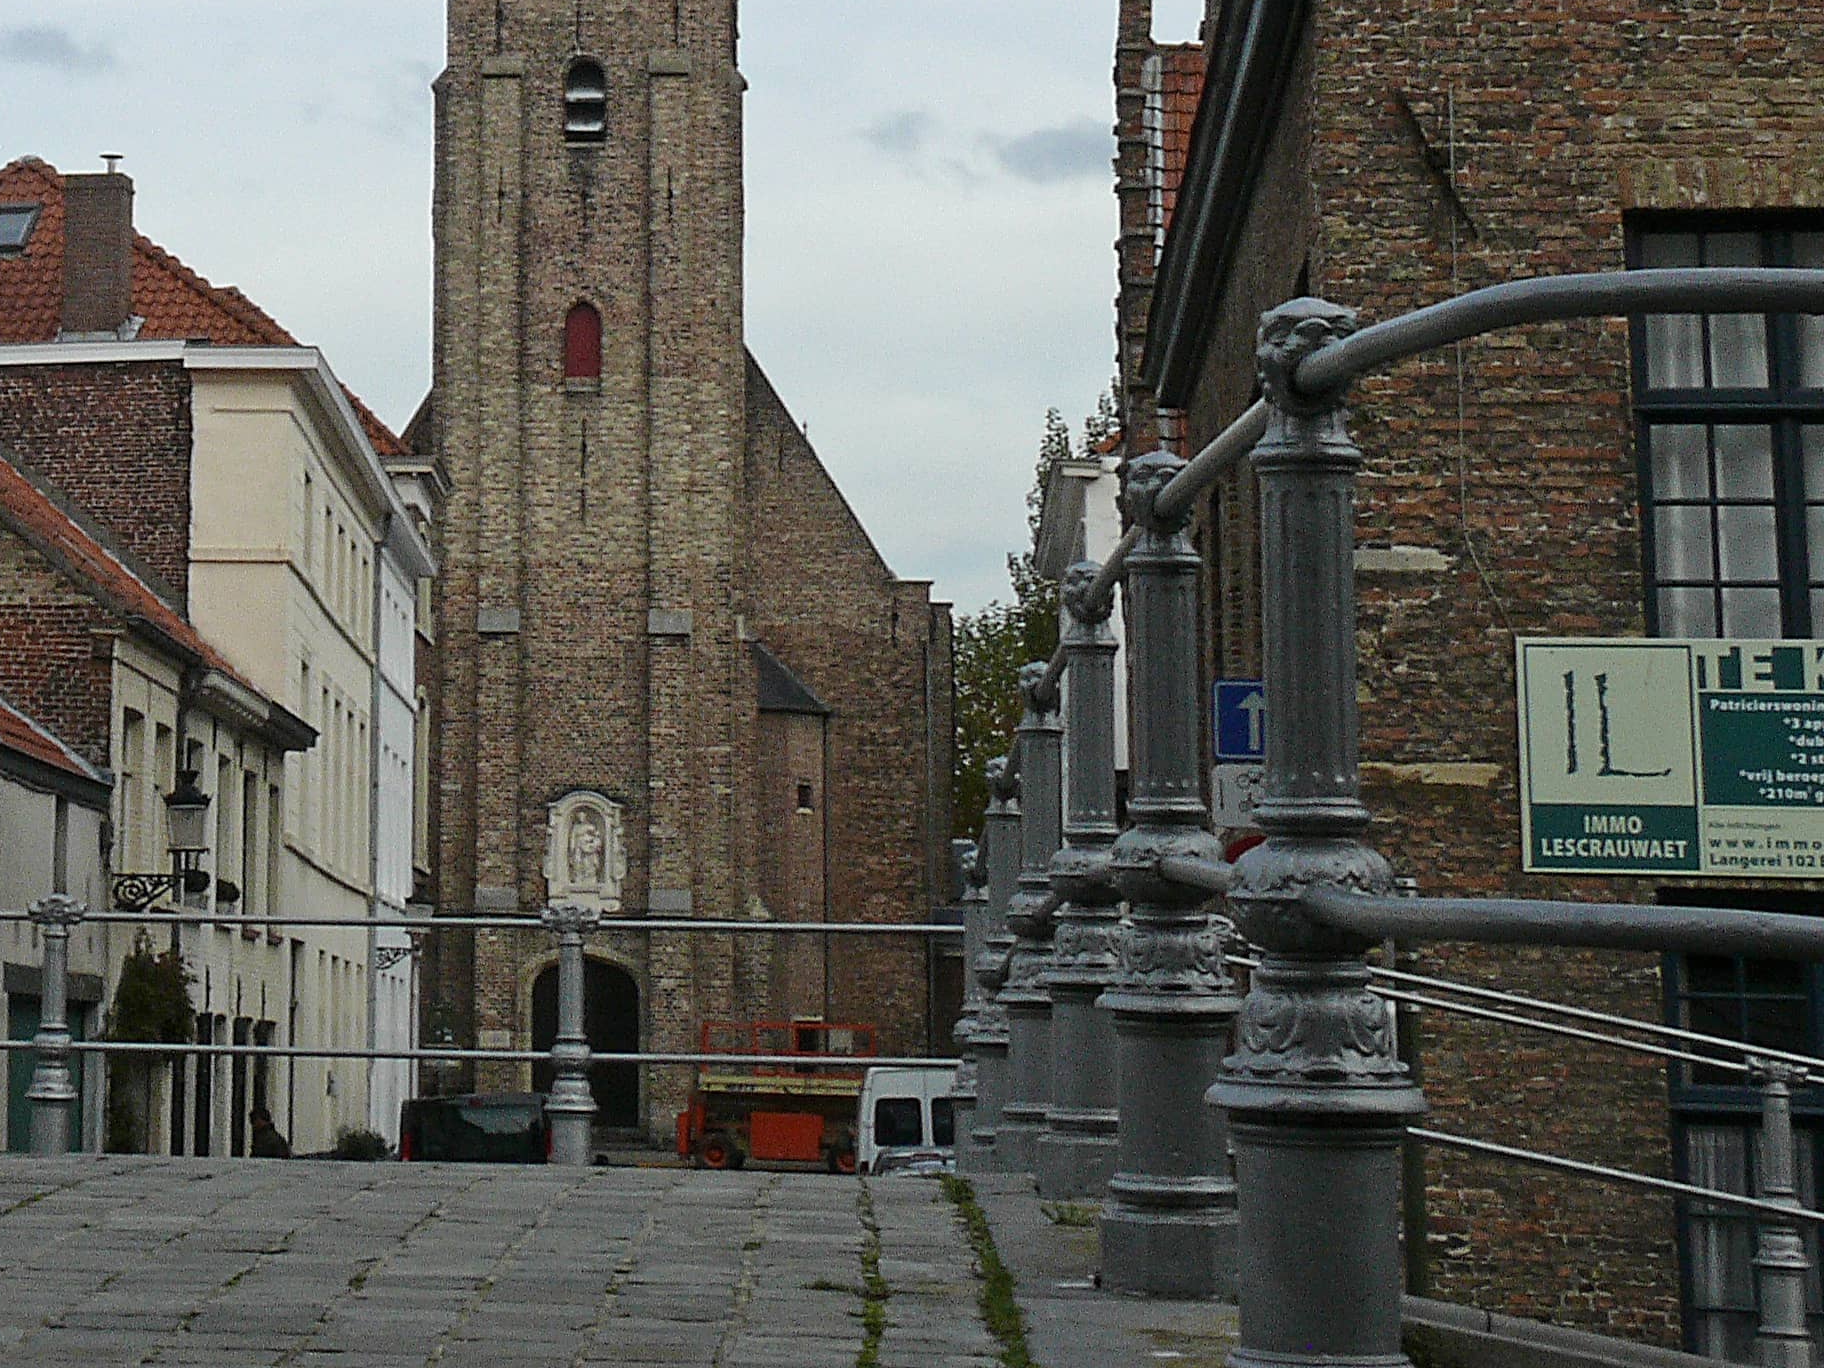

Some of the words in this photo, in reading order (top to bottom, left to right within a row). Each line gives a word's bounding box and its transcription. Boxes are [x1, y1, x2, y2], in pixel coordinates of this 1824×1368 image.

[1697, 645, 1774, 690] TE
[1583, 814, 1643, 835] IMMO
[1541, 838, 1689, 860] LESCRAUWAET
[1709, 853, 1782, 869] Langerei
[1786, 854, 1816, 868] 102
